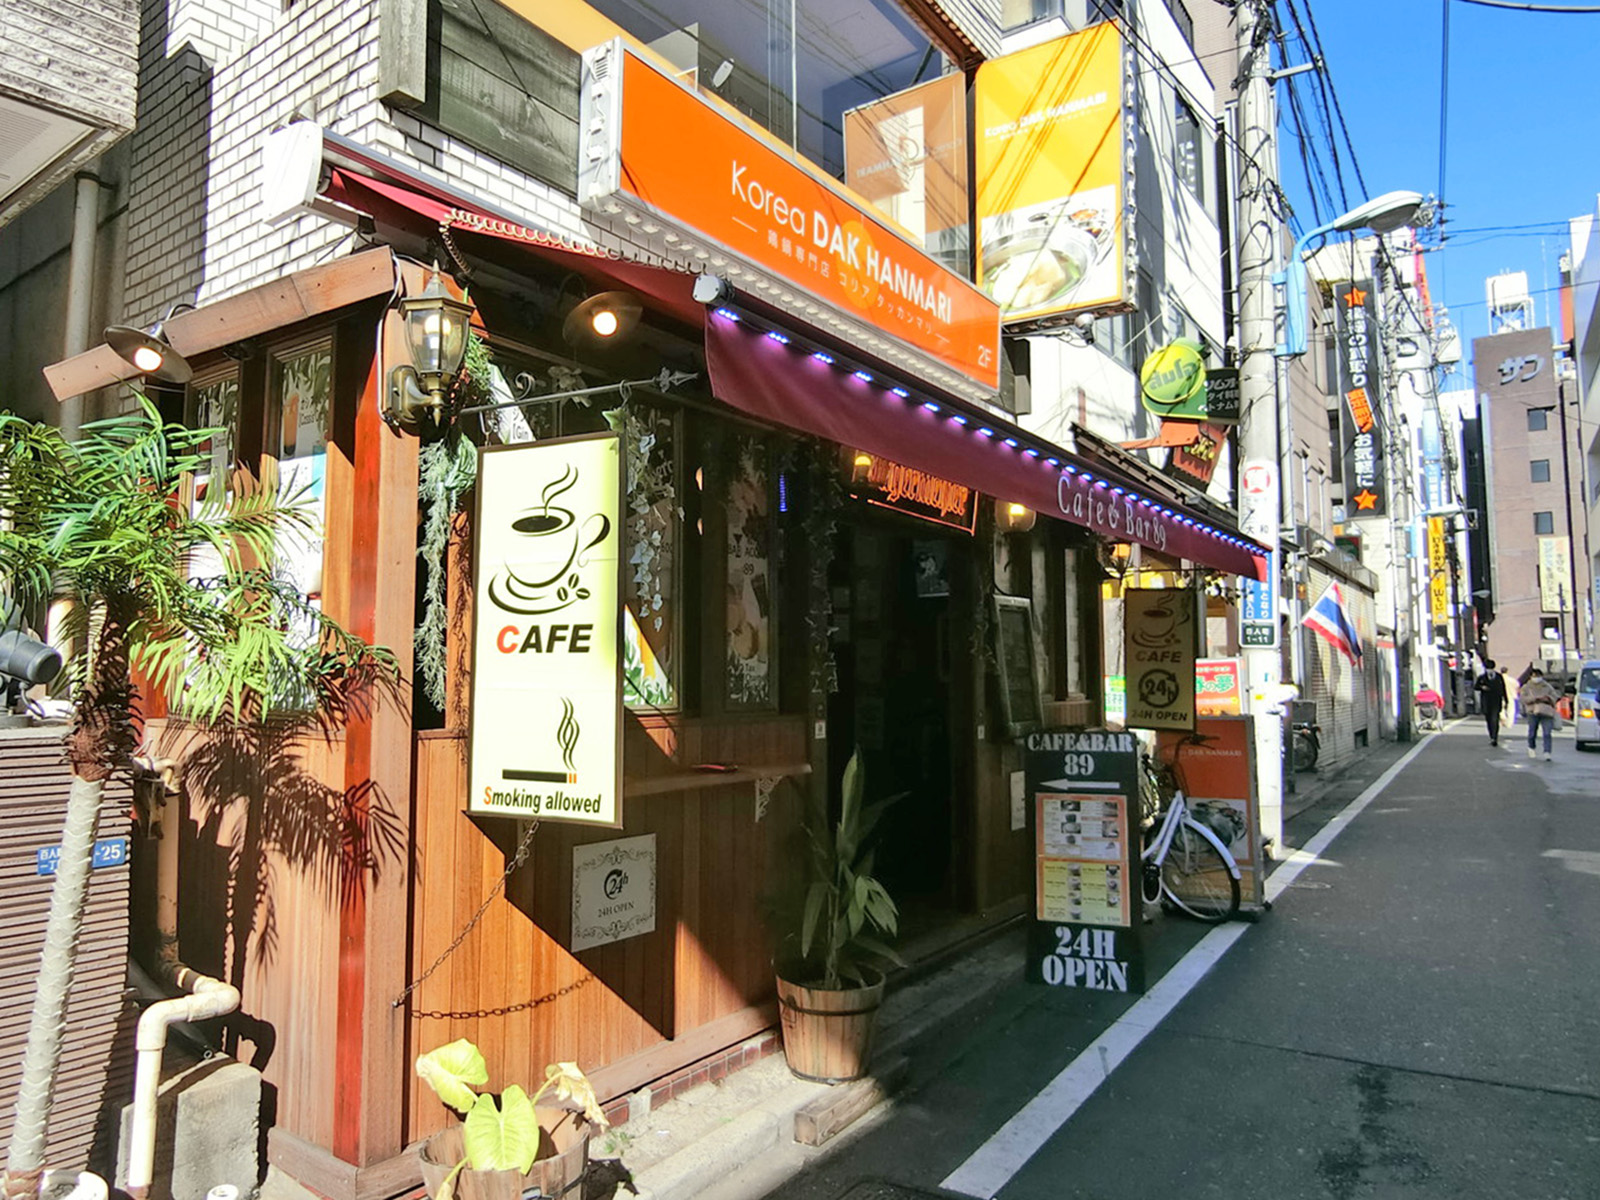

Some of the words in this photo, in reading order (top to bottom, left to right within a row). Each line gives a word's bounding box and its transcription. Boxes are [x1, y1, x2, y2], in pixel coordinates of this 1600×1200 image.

[731, 160, 806, 237] Korea
[813, 210, 860, 270] DAK
[866, 245, 951, 325] HANMARI
[977, 345, 992, 368] 2F
[1057, 475, 1105, 528] Cafe
[1124, 502, 1151, 542] Bar
[1152, 516, 1167, 552] 89
[496, 624, 594, 654] CAFE
[1135, 651, 1182, 663] CAFE
[1155, 711, 1188, 722] OPEN
[1027, 732, 1134, 752] CAFE&BAR
[1064, 753, 1096, 776] 89
[483, 786, 541, 814] Smoking
[545, 791, 602, 814] allowed
[613, 901, 635, 914] OPEN
[1055, 926, 1116, 960] 24H
[1042, 955, 1128, 993] OPEN
